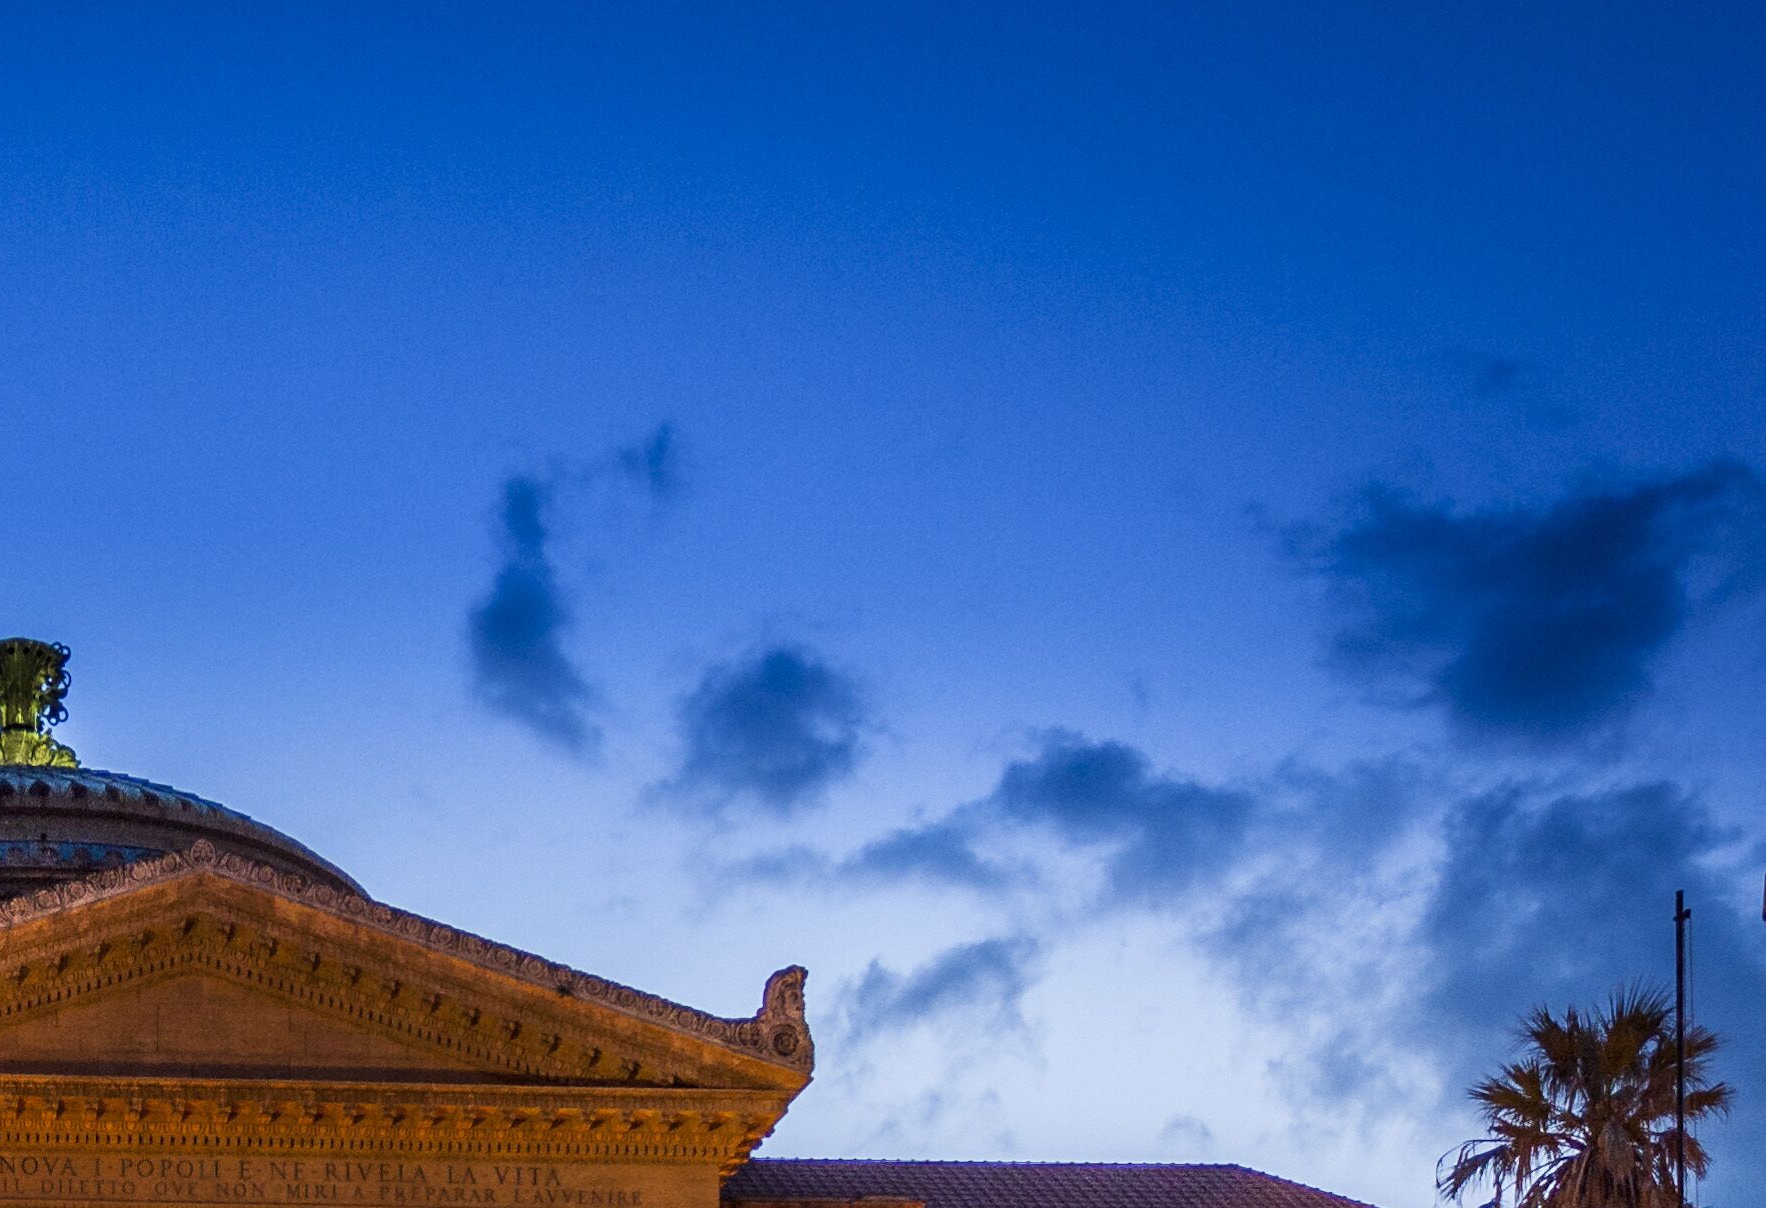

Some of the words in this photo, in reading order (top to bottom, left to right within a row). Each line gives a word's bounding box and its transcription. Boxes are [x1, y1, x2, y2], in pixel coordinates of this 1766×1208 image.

[120, 1159, 219, 1179] POPOLI
[324, 1162, 427, 1183] RIVELA
[447, 1165, 477, 1185] LA
[493, 1166, 561, 1186] VITA
[2, 1178, 25, 1194] IL
[40, 1179, 136, 1195] DILETTO
[154, 1181, 197, 1197] OVE
[215, 1183, 265, 1199] NON
[286, 1184, 338, 1200] MIRI
[379, 1186, 496, 1203] PREPARAR
[514, 1188, 643, 1206] L'AVVENIRE
